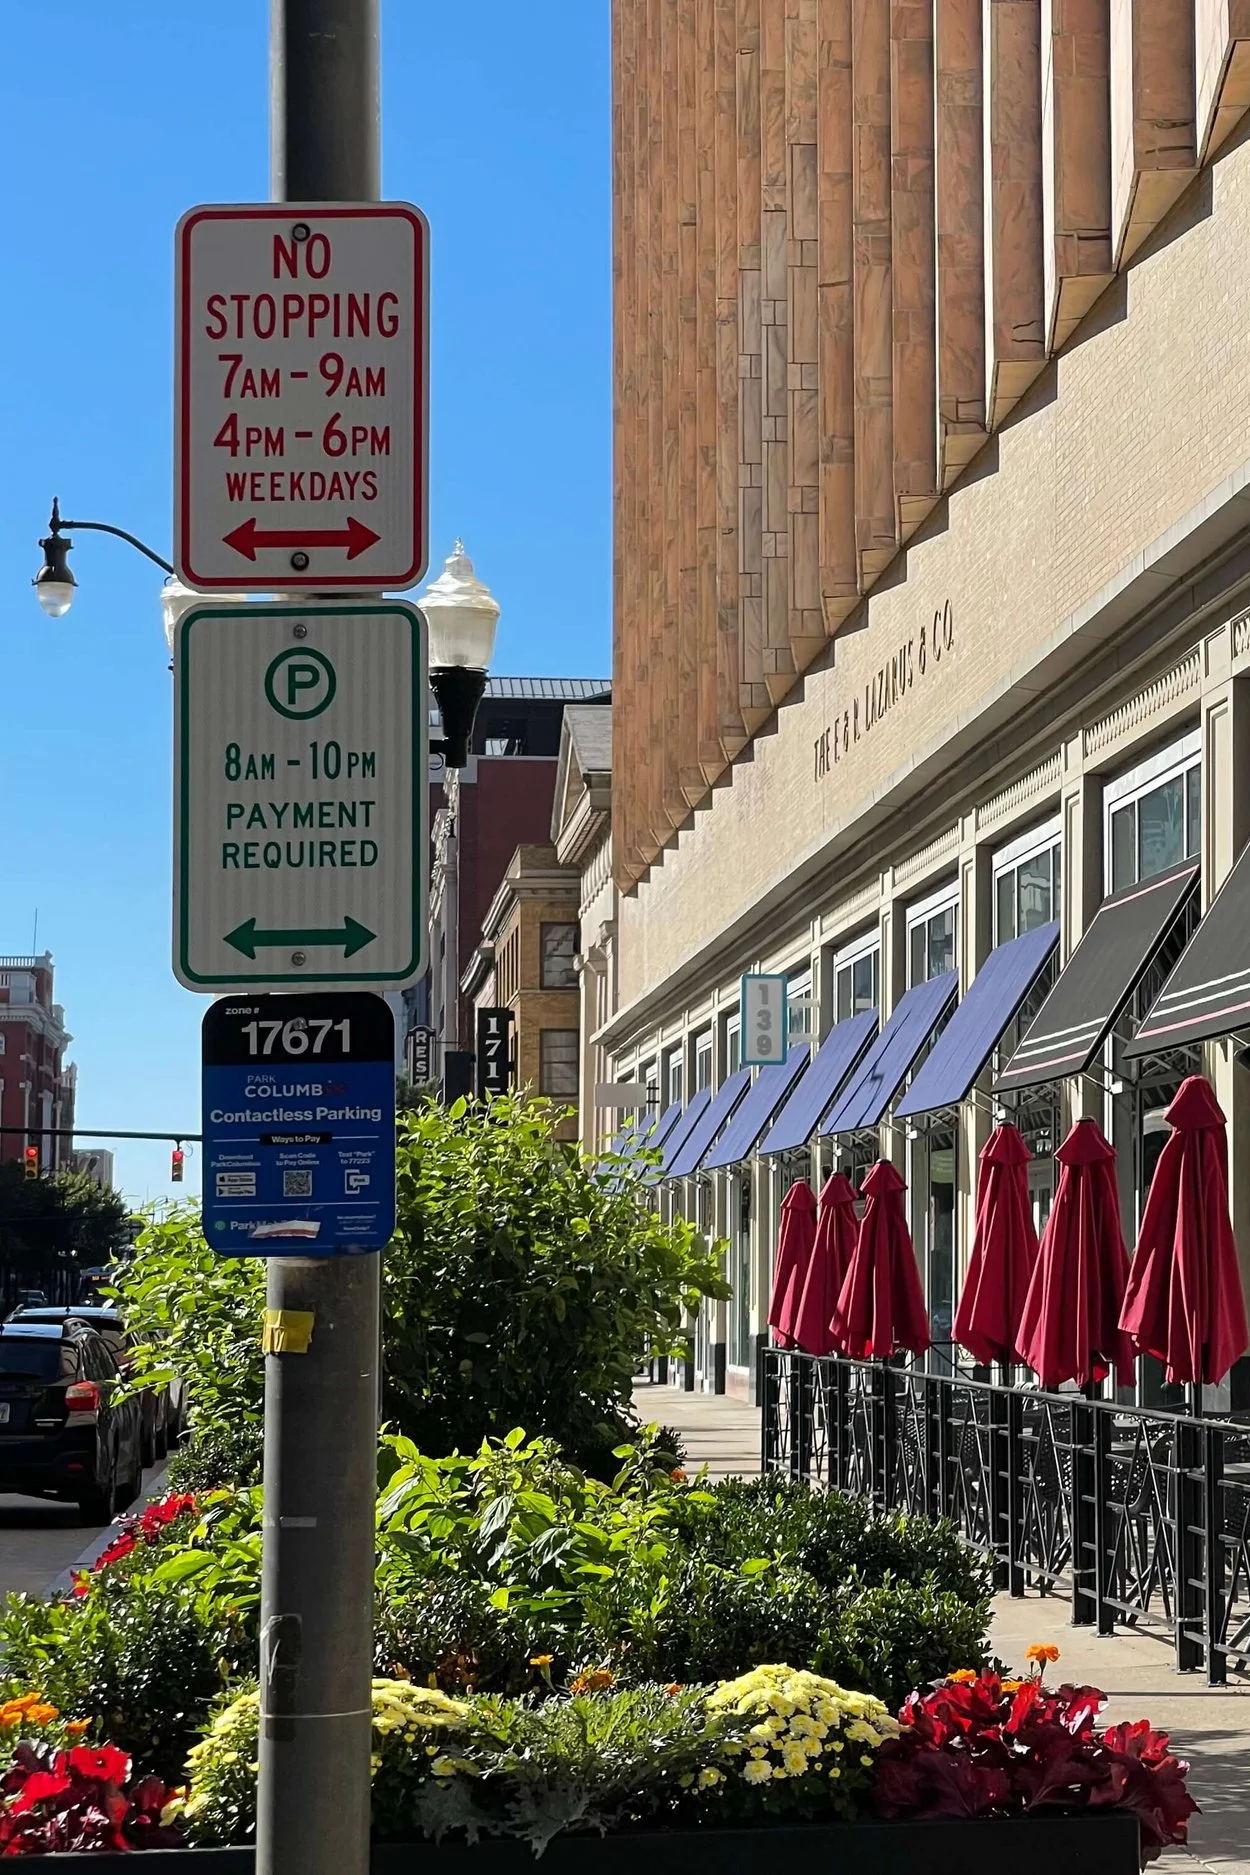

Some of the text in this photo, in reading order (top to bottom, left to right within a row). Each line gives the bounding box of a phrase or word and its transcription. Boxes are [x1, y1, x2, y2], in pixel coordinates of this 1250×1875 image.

[273, 233, 331, 279] NO
[205, 292, 399, 339] STOPPING
[226, 471, 378, 502] WEEKDAYS
[814, 727, 830, 783] THE
[865, 637, 914, 731] LAZARUS
[226, 801, 376, 830] PAYMENT
[222, 839, 379, 869] REQUIRED
[225, 1007, 252, 1015] zone
[241, 1018, 350, 1055] 17671
[485, 1017, 501, 1092] 171
[244, 1083, 346, 1098] COLUMB
[247, 1074, 276, 1084] PARK
[210, 1106, 382, 1123] Contactless Parking
[271, 1135, 294, 1144] Ways
[305, 1135, 321, 1143] Pay
